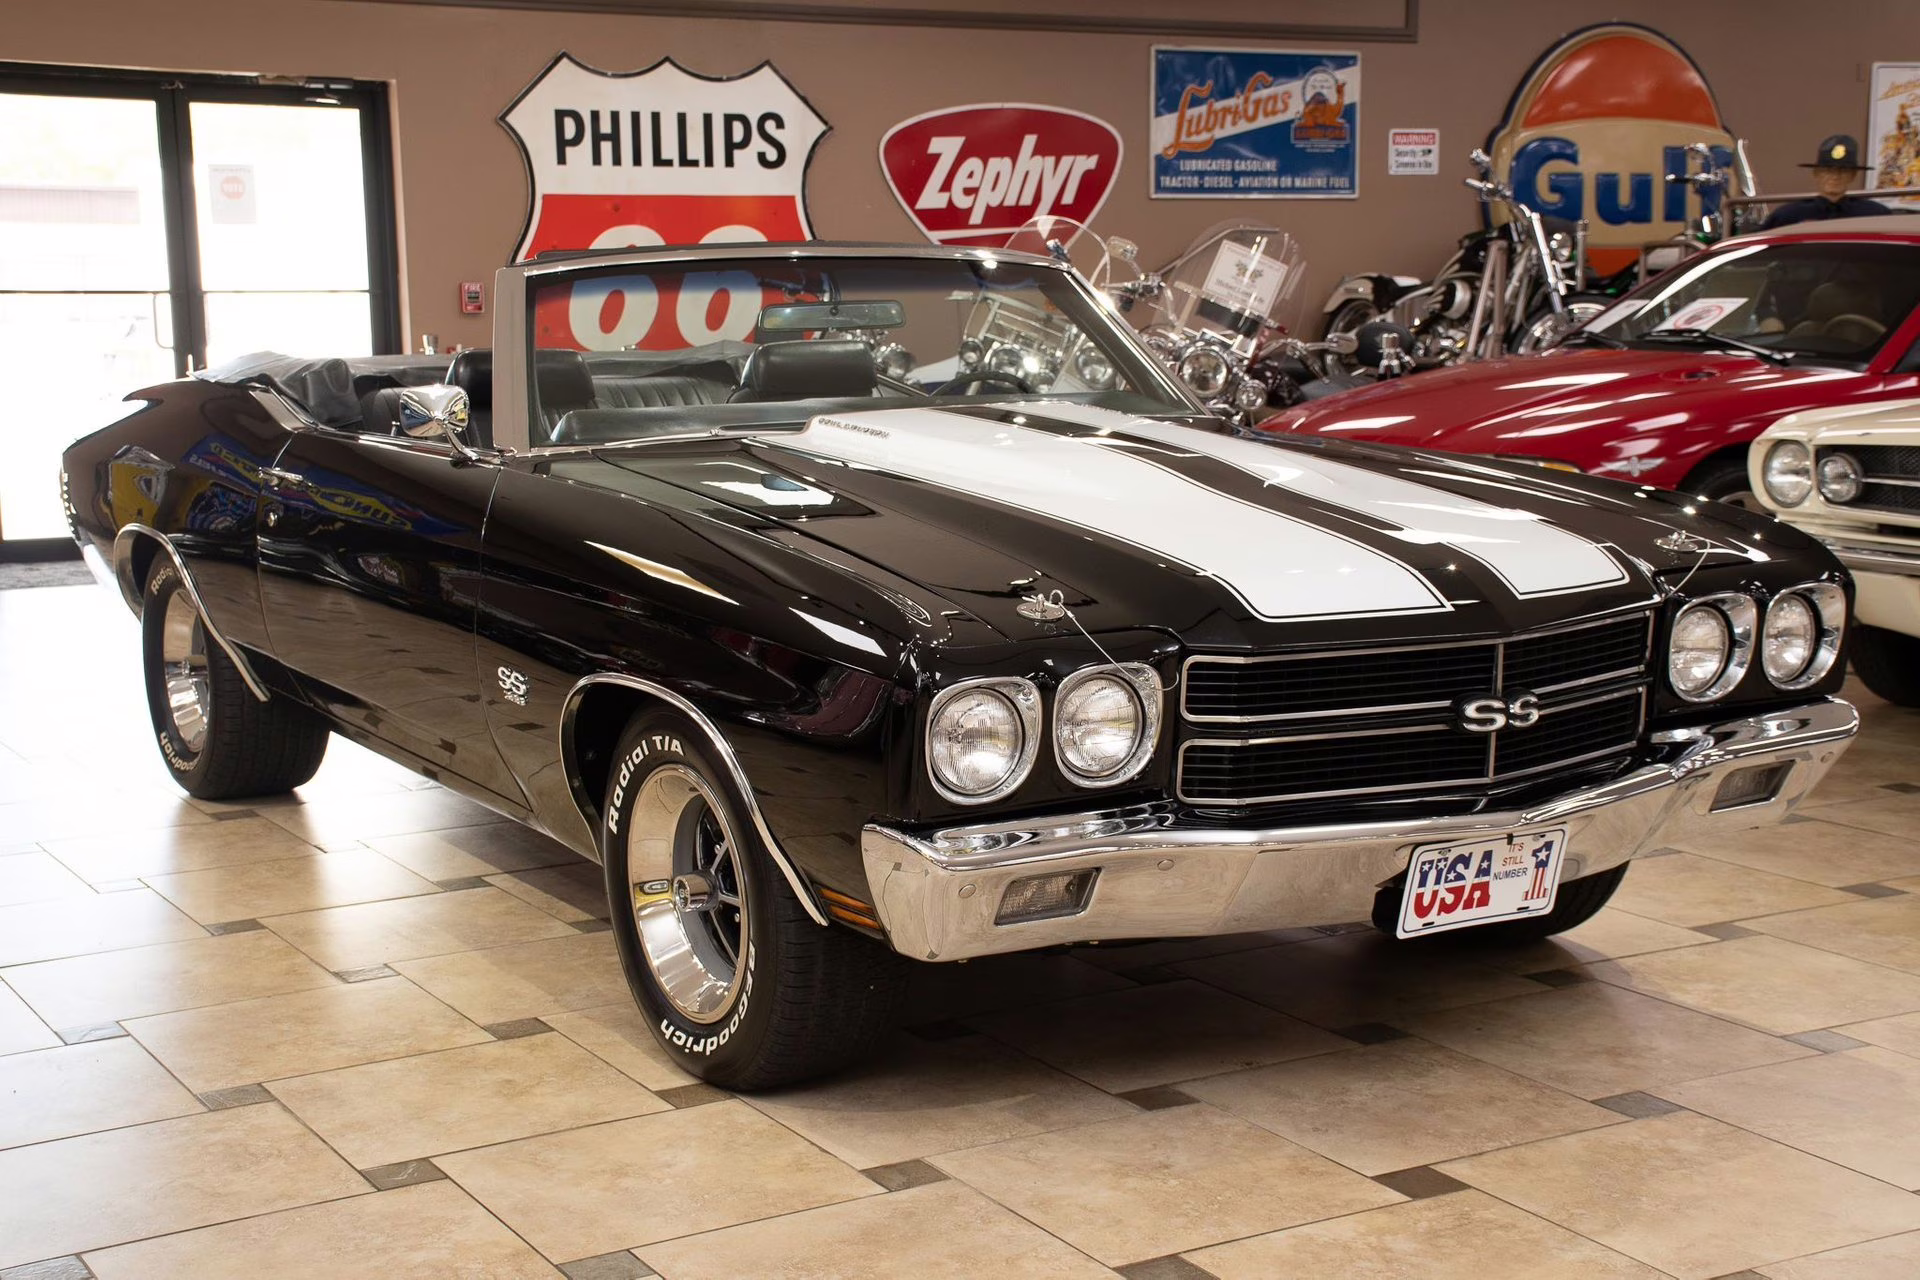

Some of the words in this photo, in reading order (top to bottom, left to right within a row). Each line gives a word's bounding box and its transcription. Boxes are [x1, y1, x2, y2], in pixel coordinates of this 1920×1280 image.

[554, 108, 786, 169] PHILLIPS
[914, 134, 1099, 240] Zephyr
[1160, 175, 1200, 188] TRACTOR
[1203, 175, 1233, 188] DIESEL
[1238, 175, 1279, 188] AVIATION
[1280, 175, 1293, 188] OR
[1294, 175, 1328, 188] MARINE
[1328, 175, 1350, 189] FUEL
[1180, 158, 1233, 172] LUBRICATED
[1233, 158, 1278, 172] GASOLINE
[497, 666, 527, 696] SS
[1463, 694, 1539, 732] SS
[608, 740, 649, 835] Radial
[1413, 850, 1494, 919] USA
[1493, 867, 1528, 880] NUMBER
[1502, 856, 1524, 867] STILL
[1522, 840, 1554, 901] 1
[659, 939, 756, 1056] BFGoodrich
